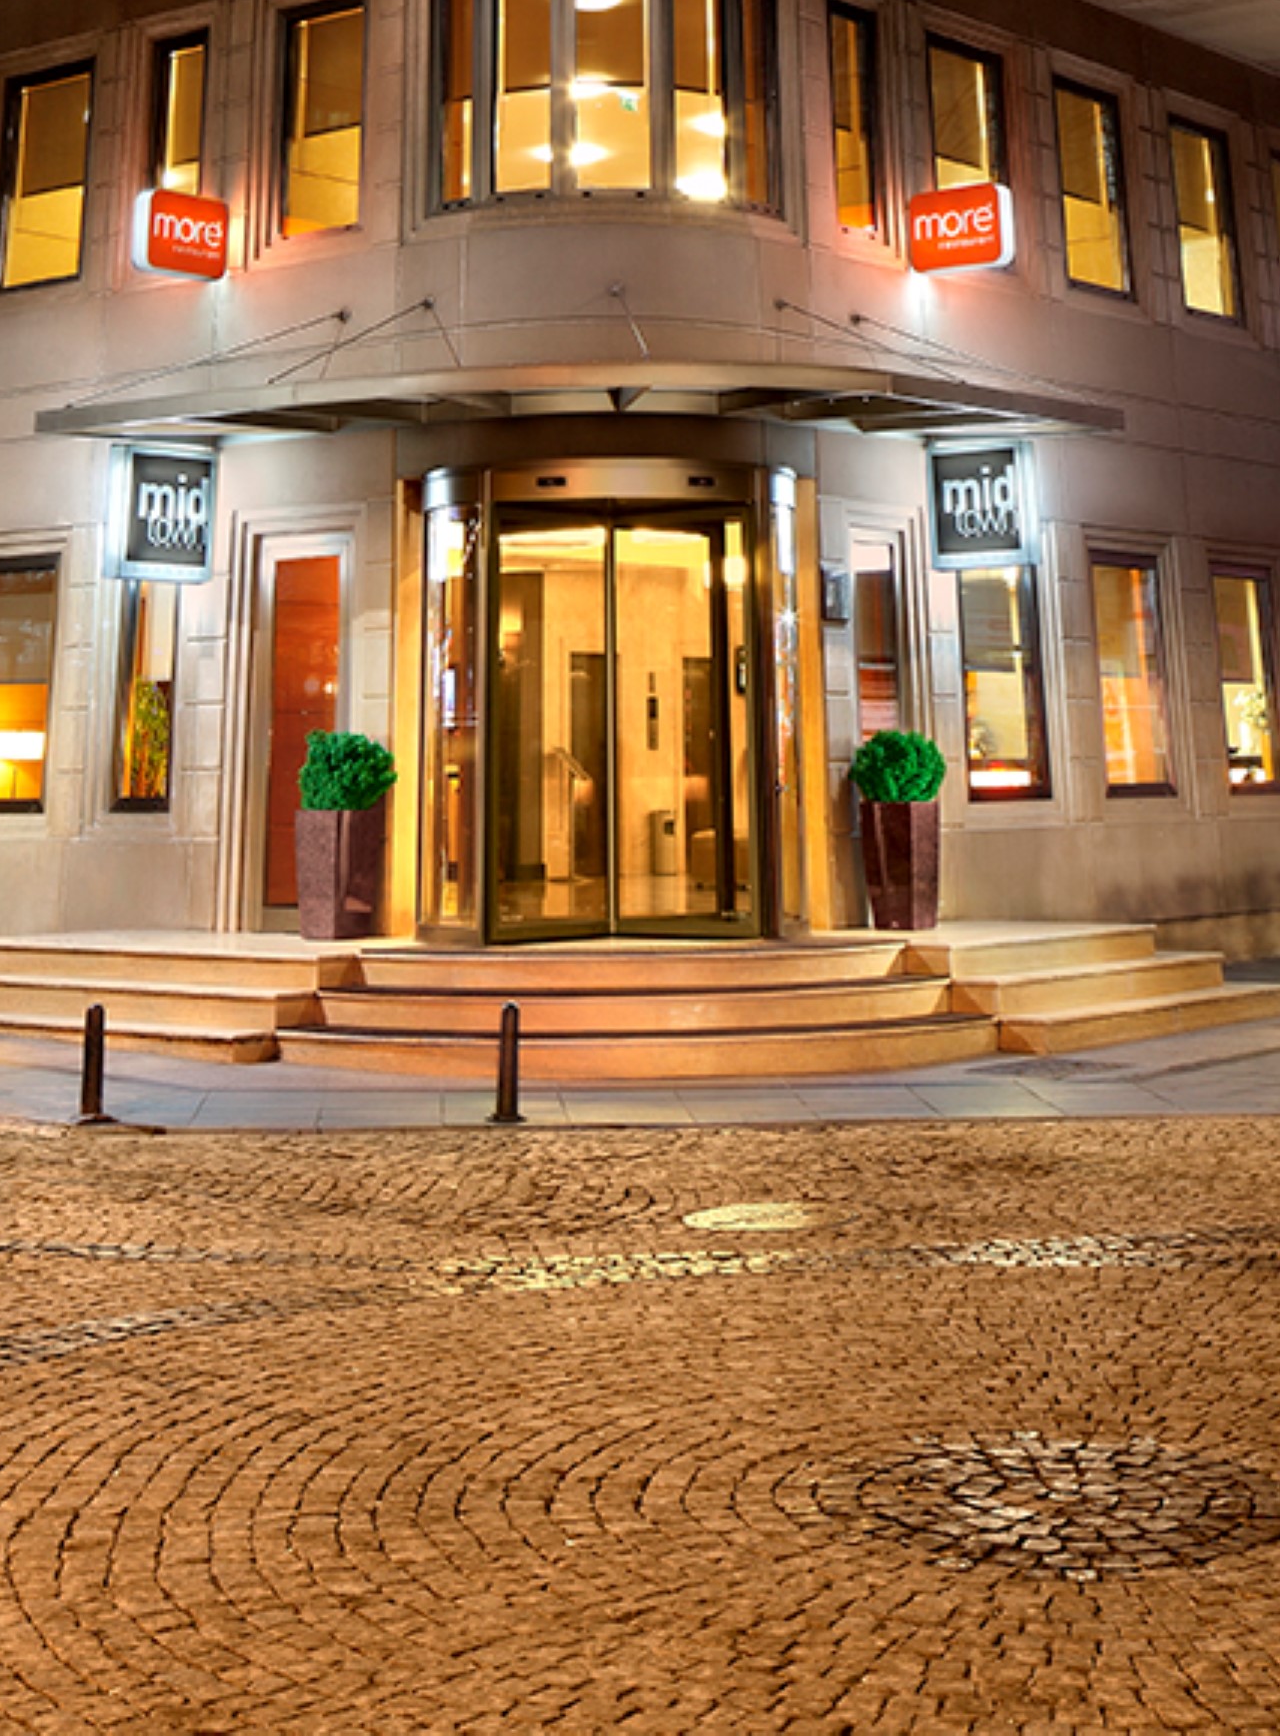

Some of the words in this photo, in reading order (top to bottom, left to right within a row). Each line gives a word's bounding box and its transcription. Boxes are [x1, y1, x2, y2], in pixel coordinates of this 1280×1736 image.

[153, 212, 223, 248] more
[914, 205, 994, 240] more
[138, 473, 210, 523] mid
[942, 465, 1014, 514] mid
